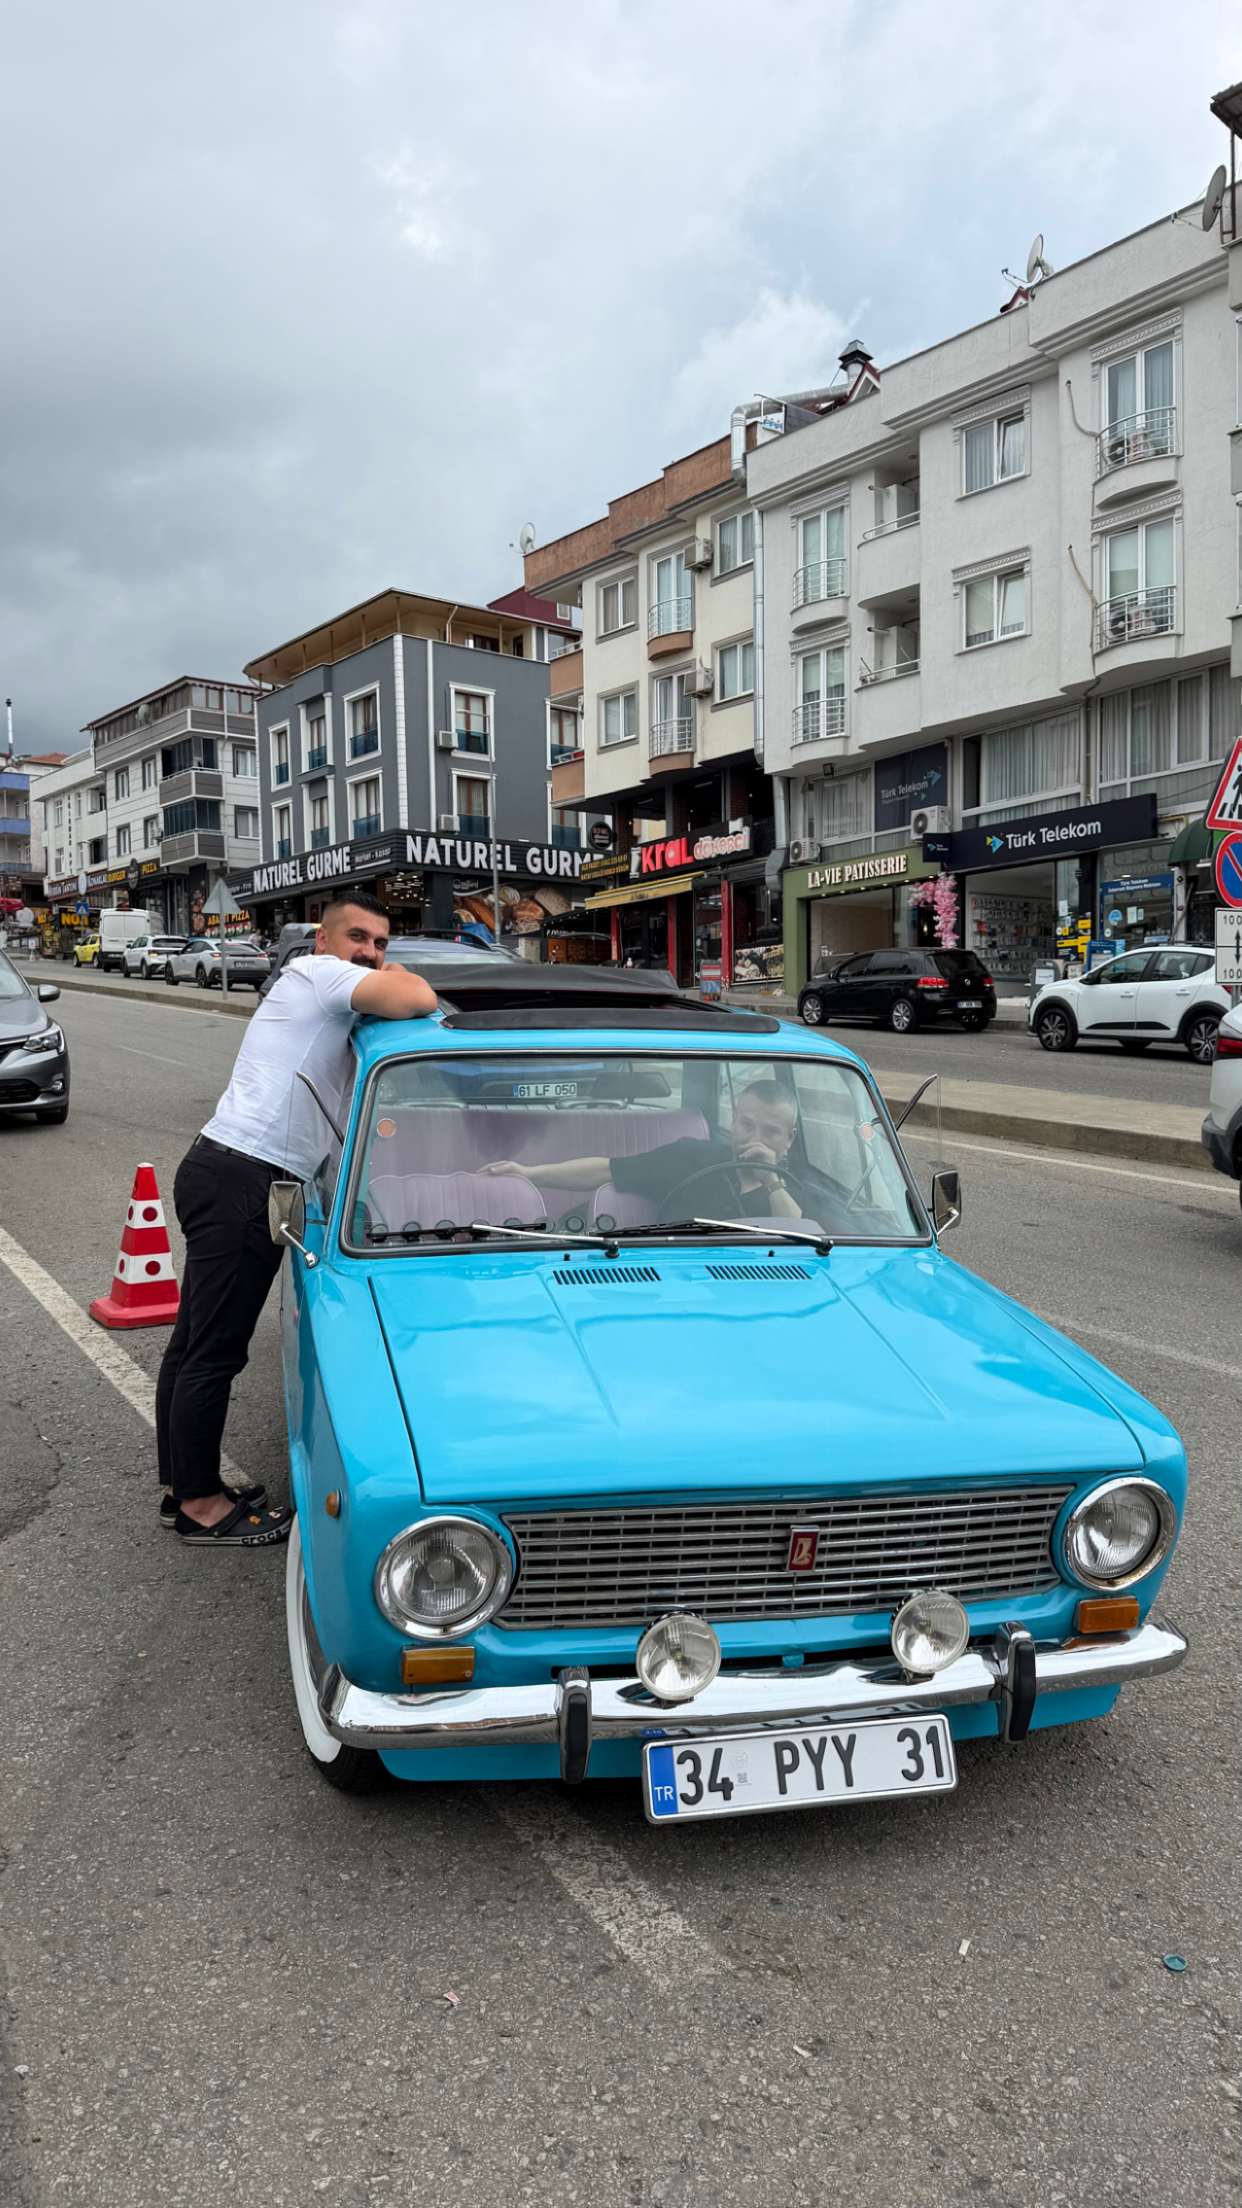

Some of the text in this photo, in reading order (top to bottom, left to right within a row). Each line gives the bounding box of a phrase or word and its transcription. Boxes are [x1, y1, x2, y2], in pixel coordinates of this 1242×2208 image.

[1006, 821, 1101, 849] Türk Telekom
[253, 846, 350, 893] NATUREL GURME
[406, 835, 517, 872] NATUREL
[526, 847, 604, 877] GURM
[808, 854, 907, 888] LA-VIE PATISSERIE
[519, 1084, 576, 1097] 61 LF 050
[654, 1725, 944, 1806] TR 34 PYY 31
